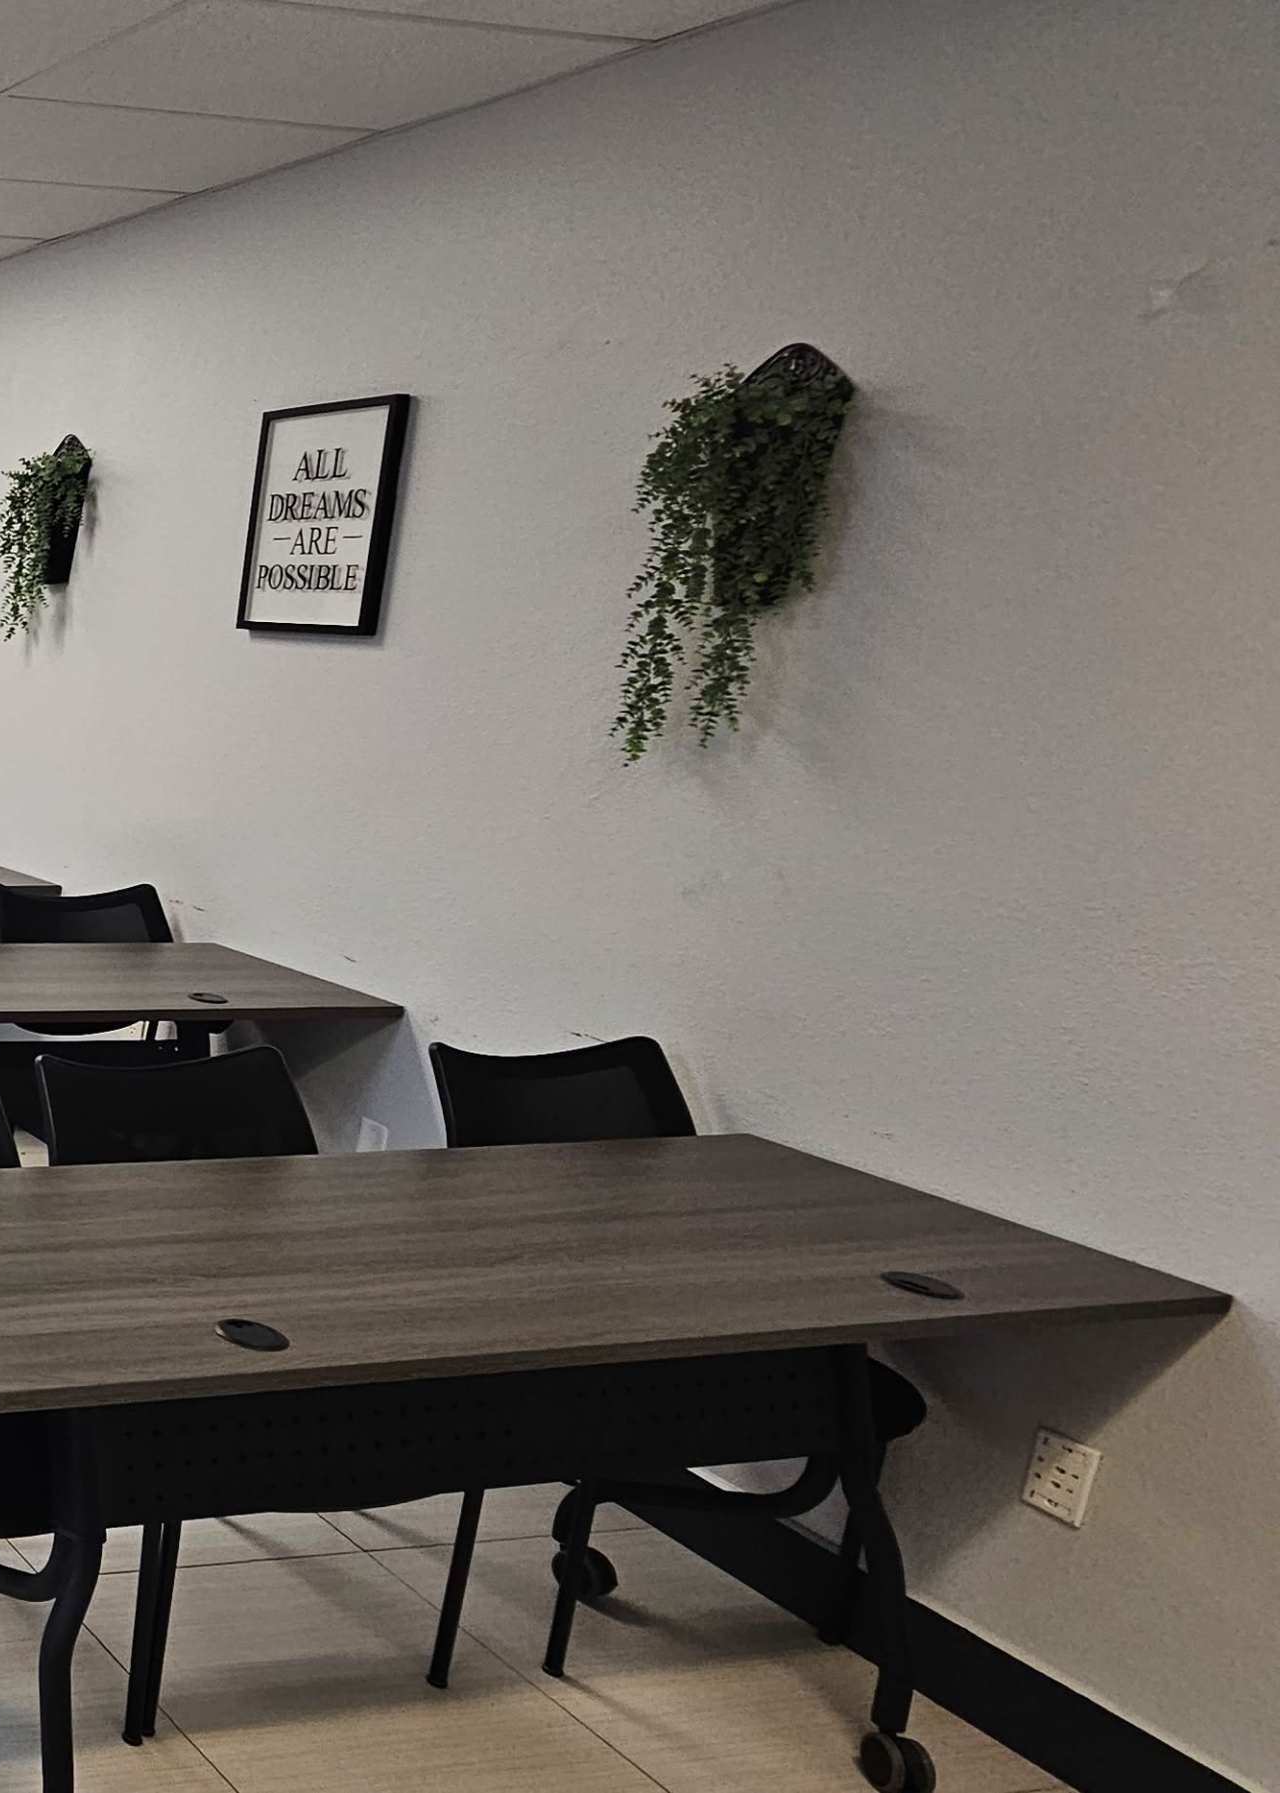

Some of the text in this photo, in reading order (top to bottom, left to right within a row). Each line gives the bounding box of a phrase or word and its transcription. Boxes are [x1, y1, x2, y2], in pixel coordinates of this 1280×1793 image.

[292, 448, 348, 481] ALL
[267, 489, 367, 521] DREAMS
[290, 527, 339, 555] ARE
[256, 564, 359, 591] POSSIBLE
